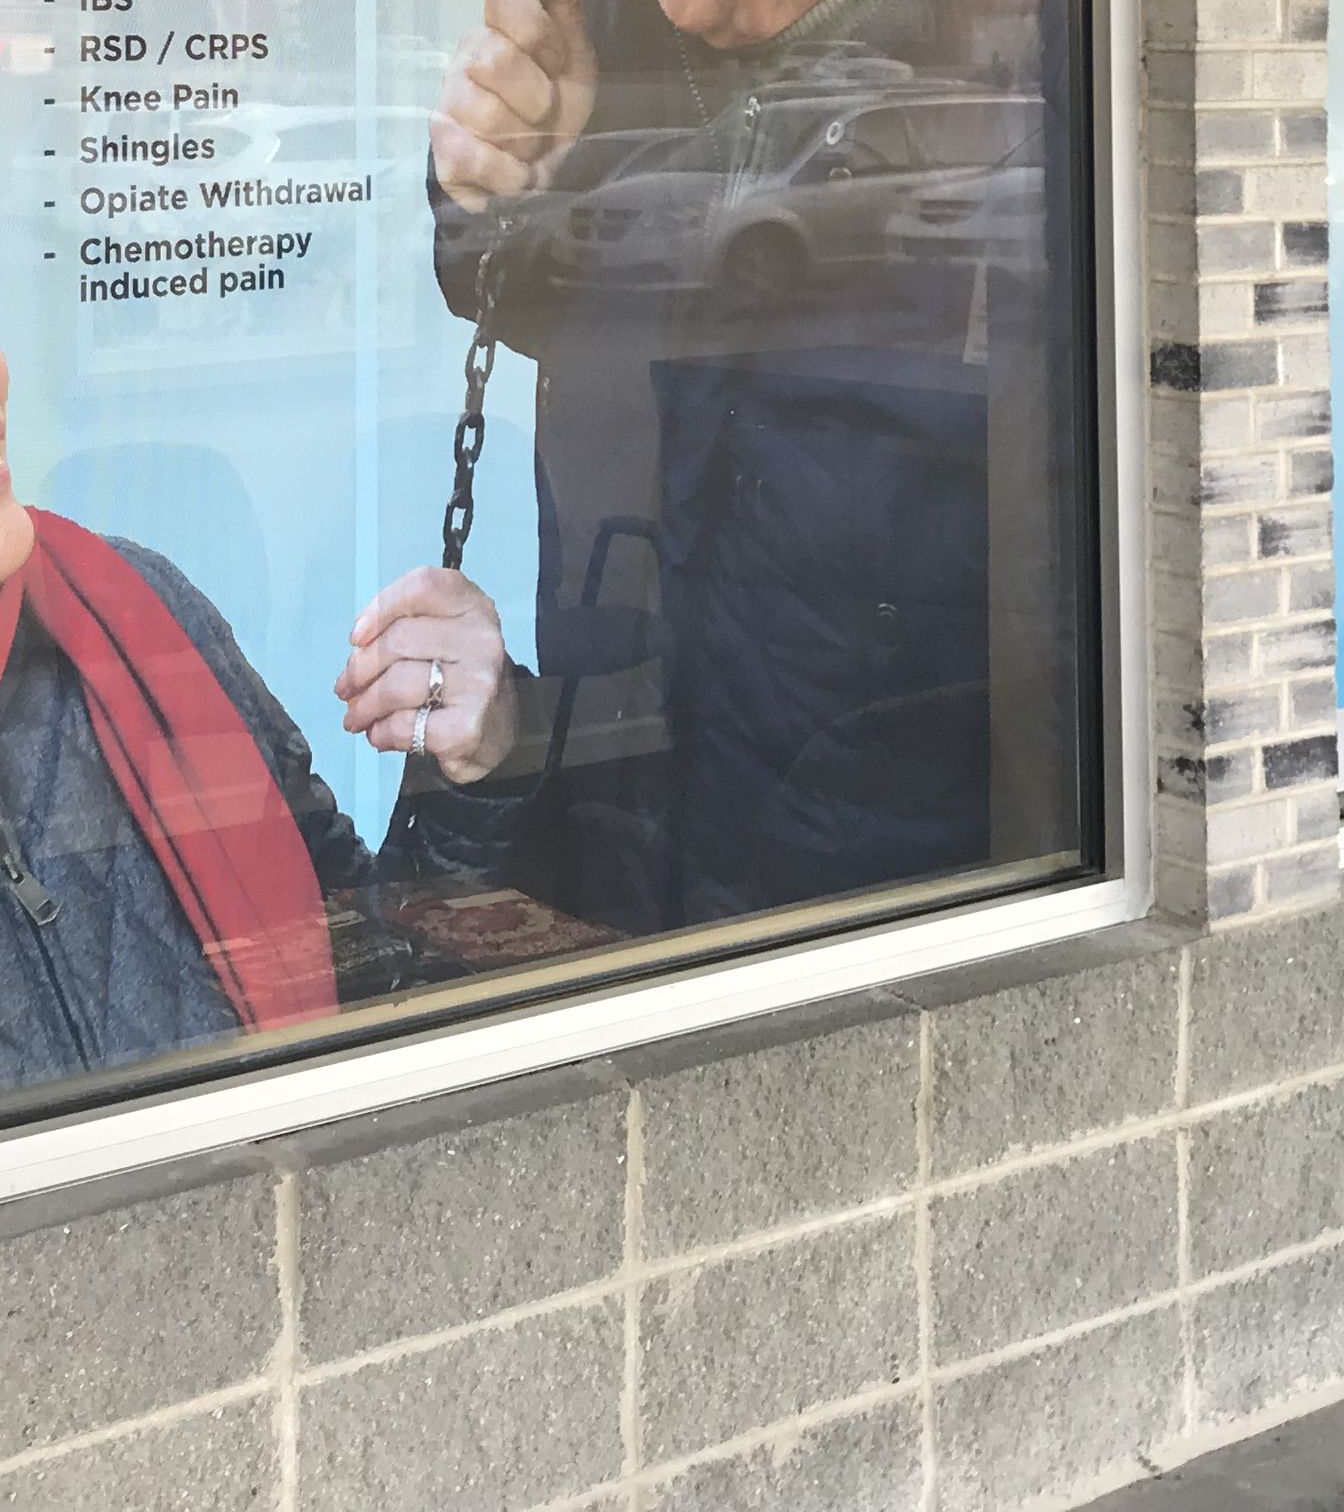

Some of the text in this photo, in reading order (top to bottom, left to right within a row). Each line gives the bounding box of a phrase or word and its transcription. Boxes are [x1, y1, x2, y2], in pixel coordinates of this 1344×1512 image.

[80, 35, 147, 62] RSD
[157, 31, 174, 65] /
[185, 34, 269, 61] CRPS
[80, 86, 162, 112] Knee
[173, 84, 239, 110] Pain
[80, 133, 216, 166] Shingles
[80, 185, 188, 218] Opiate
[199, 175, 372, 208] Withdrawal
[80, 230, 313, 265] Chemotherapy
[80, 264, 285, 301] induced pain
